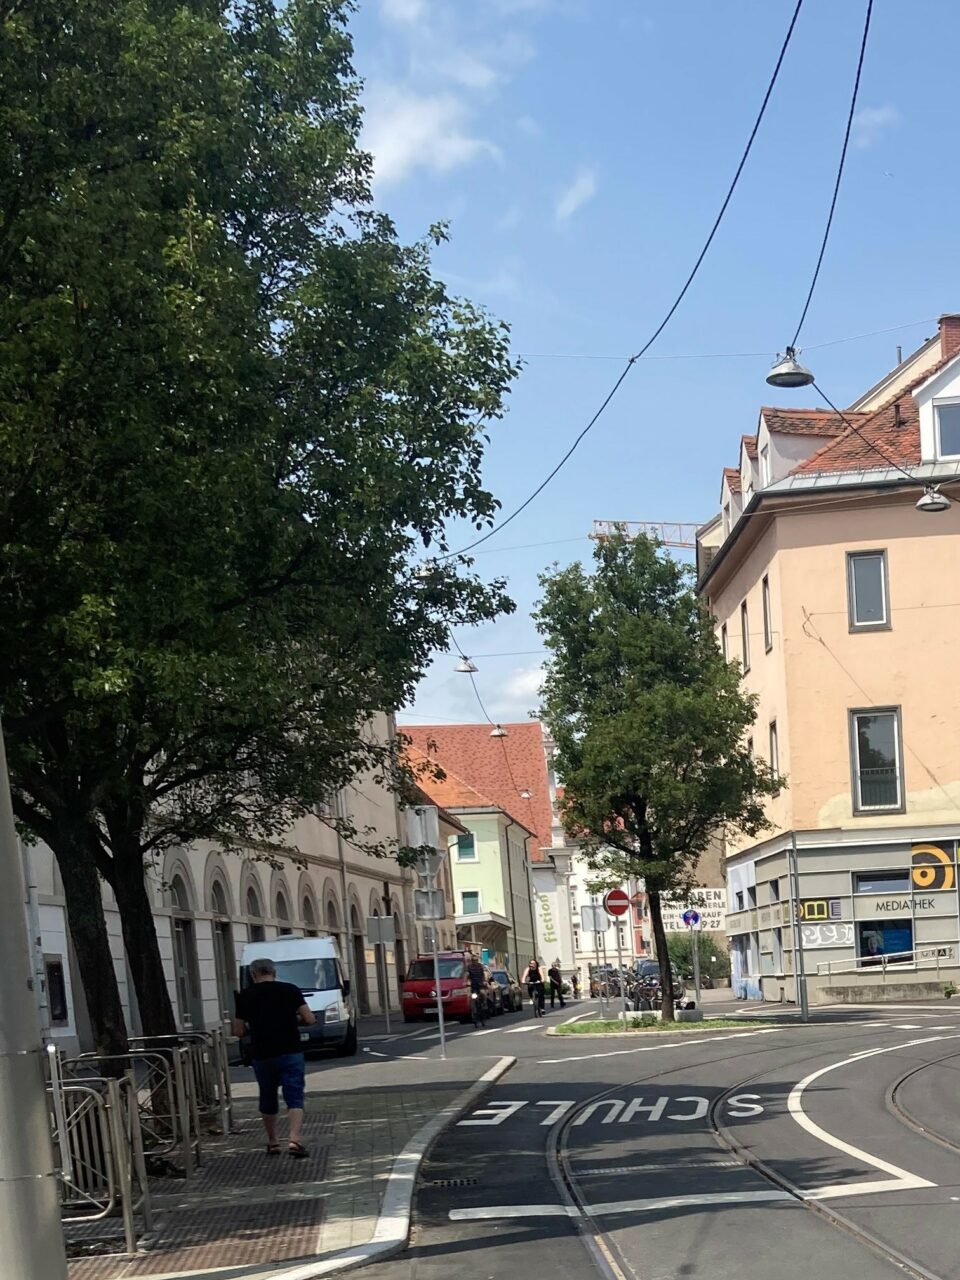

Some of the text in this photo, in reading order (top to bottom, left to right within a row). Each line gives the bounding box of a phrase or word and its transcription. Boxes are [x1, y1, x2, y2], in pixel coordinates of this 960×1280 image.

[539, 894, 558, 943] fiction
[876, 899, 935, 911] MEDIATHEK
[455, 1093, 765, 1126] SCHULE
